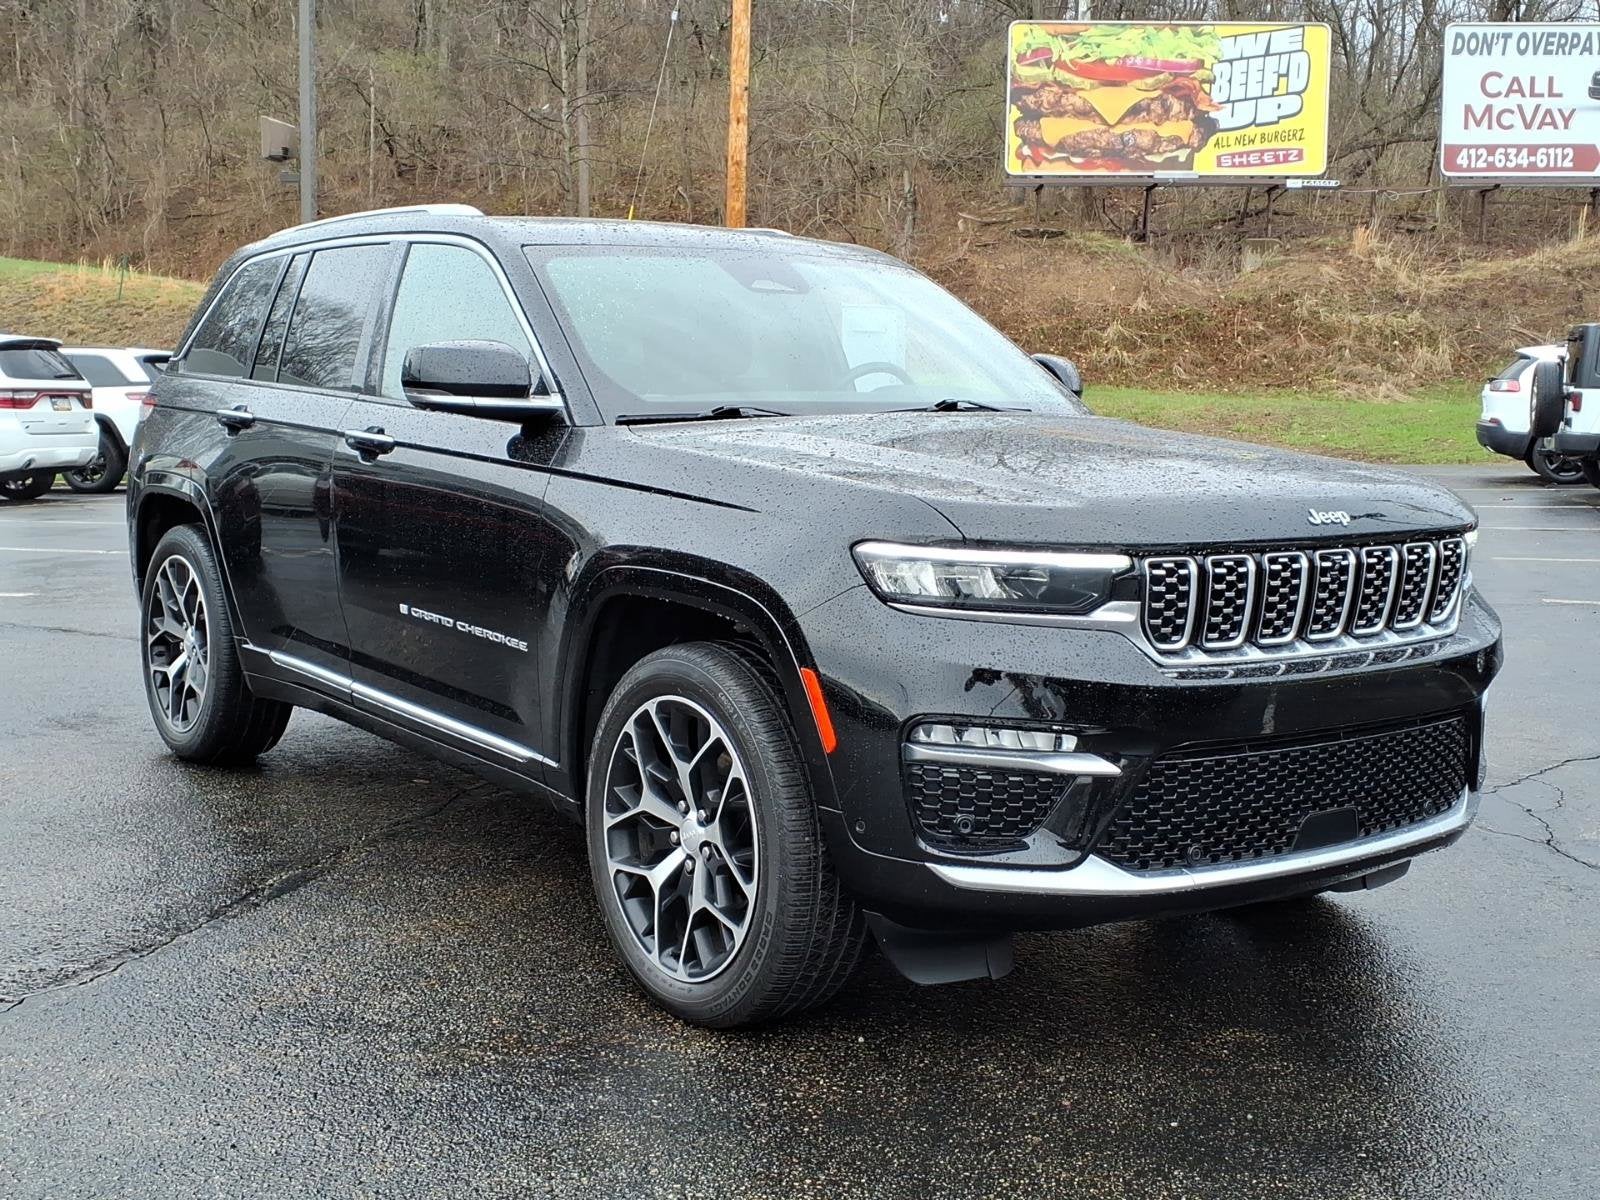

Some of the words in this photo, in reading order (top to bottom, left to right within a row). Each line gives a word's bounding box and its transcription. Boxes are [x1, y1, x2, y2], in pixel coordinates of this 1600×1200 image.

[1220, 25, 1305, 60] WE
[1451, 32, 1513, 56] DON'T
[1210, 50, 1310, 103] BEEF'D
[1480, 71, 1563, 98] CALL
[1209, 94, 1303, 132] UP
[1213, 136, 1231, 149] ALL
[1233, 133, 1257, 147] NEW
[1259, 128, 1305, 145] BURGERZ
[1220, 149, 1299, 167] SHEETZ
[1456, 147, 1574, 168] 412-634-6112
[1307, 508, 1351, 526] Jeep
[410, 607, 454, 628] GRAND
[455, 620, 528, 652] CHEROKEE
